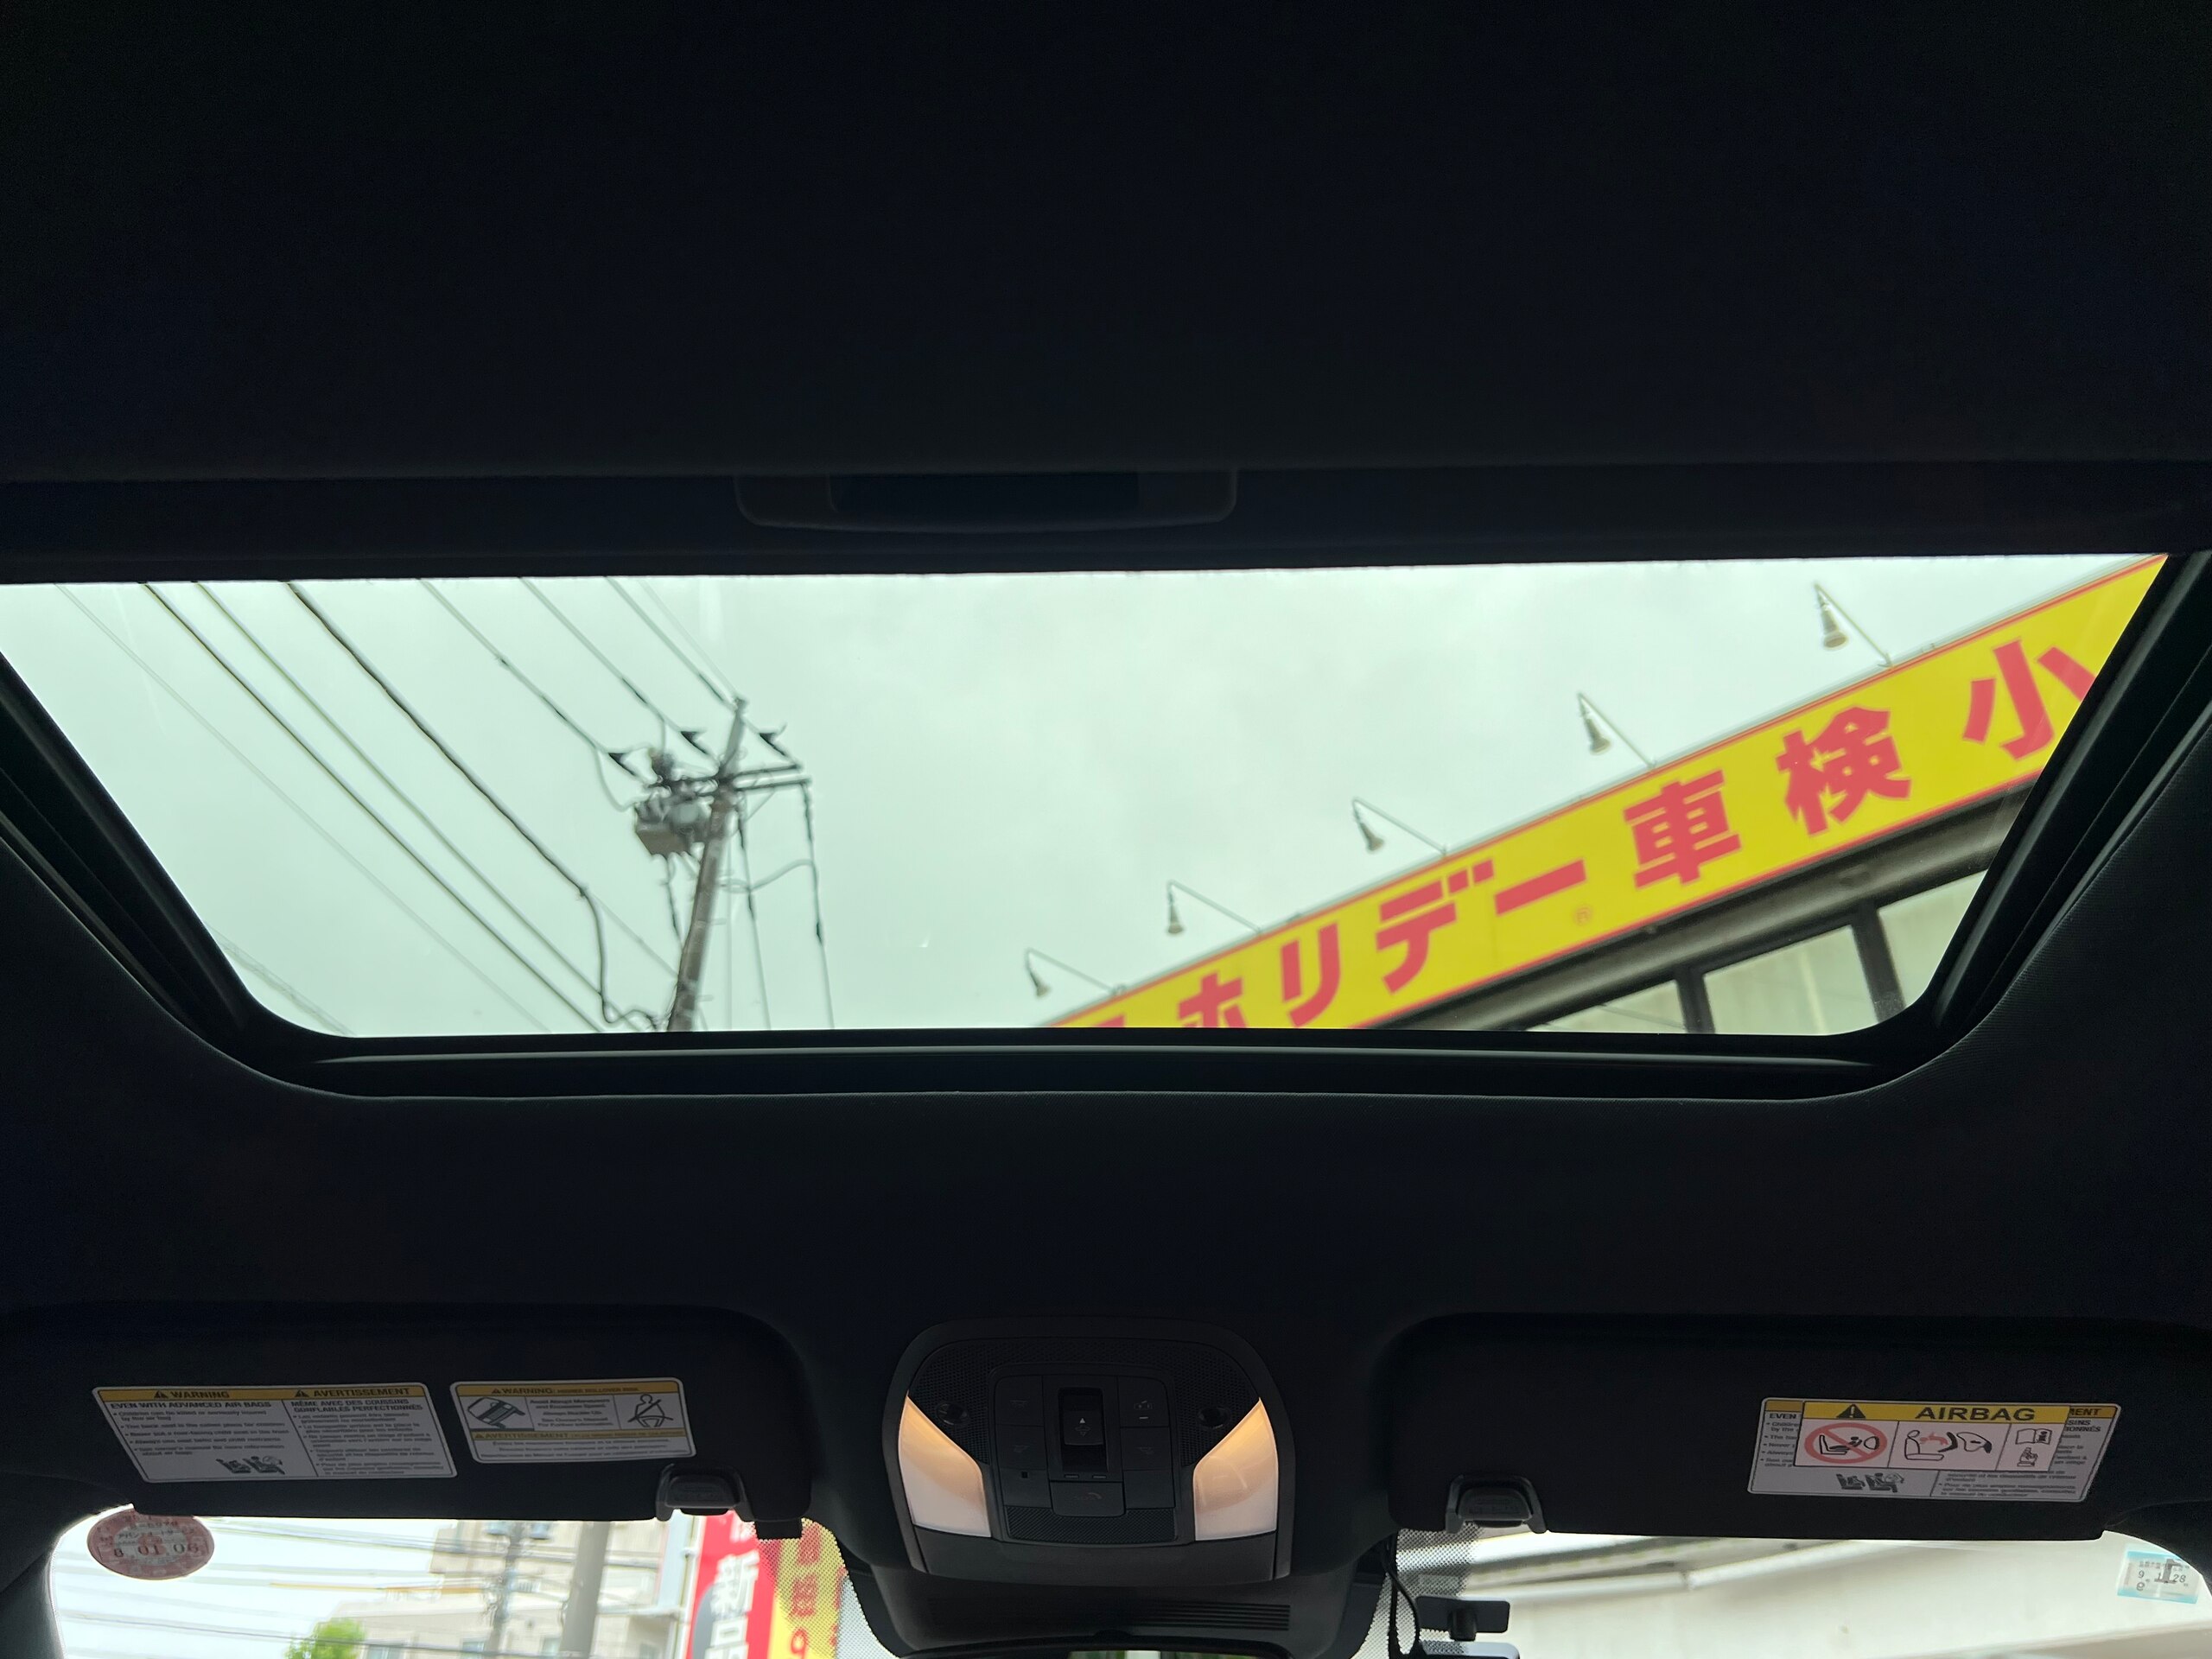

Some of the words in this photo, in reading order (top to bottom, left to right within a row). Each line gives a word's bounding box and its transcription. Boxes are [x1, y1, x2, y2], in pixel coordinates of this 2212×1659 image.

[170, 1390, 230, 1399] WARNING
[314, 1388, 410, 1397] AVERTISSEMENT
[1915, 1407, 2035, 1421] AIRBAG
